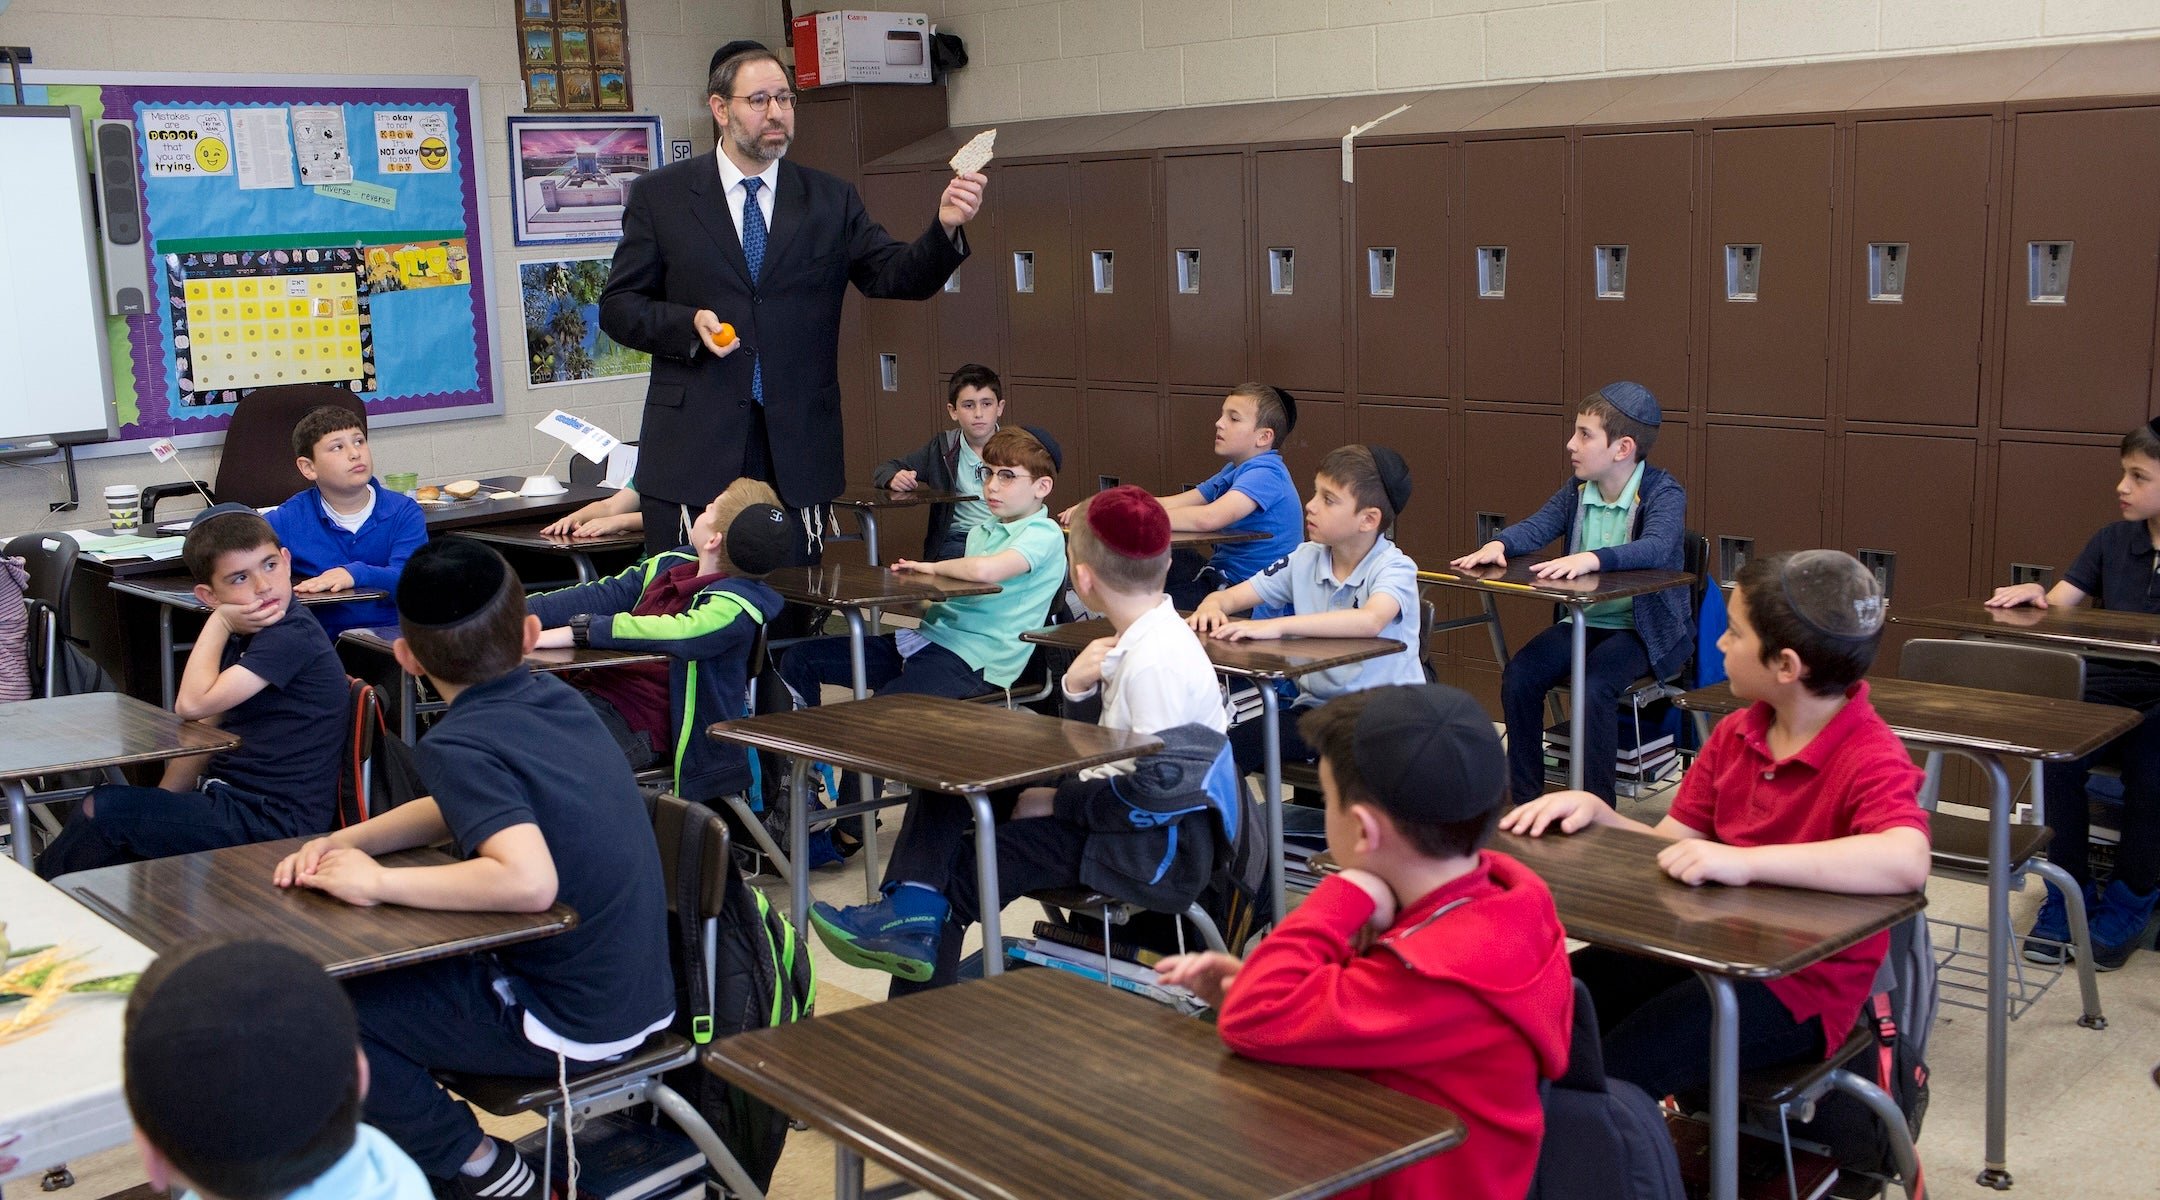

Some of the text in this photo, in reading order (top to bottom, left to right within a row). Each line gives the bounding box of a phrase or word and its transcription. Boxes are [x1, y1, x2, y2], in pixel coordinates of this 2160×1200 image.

[151, 112, 190, 121] Mistakes
[392, 113, 413, 122] okay
[148, 130, 198, 141] proof
[163, 143, 182, 151] that
[380, 147, 419, 156] NOT okay
[157, 154, 173, 162] you
[155, 162, 195, 172] trying.
[387, 163, 413, 172] try
[361, 192, 391, 205] reverse
[880, 914, 937, 932] UNDER ARMOUR
